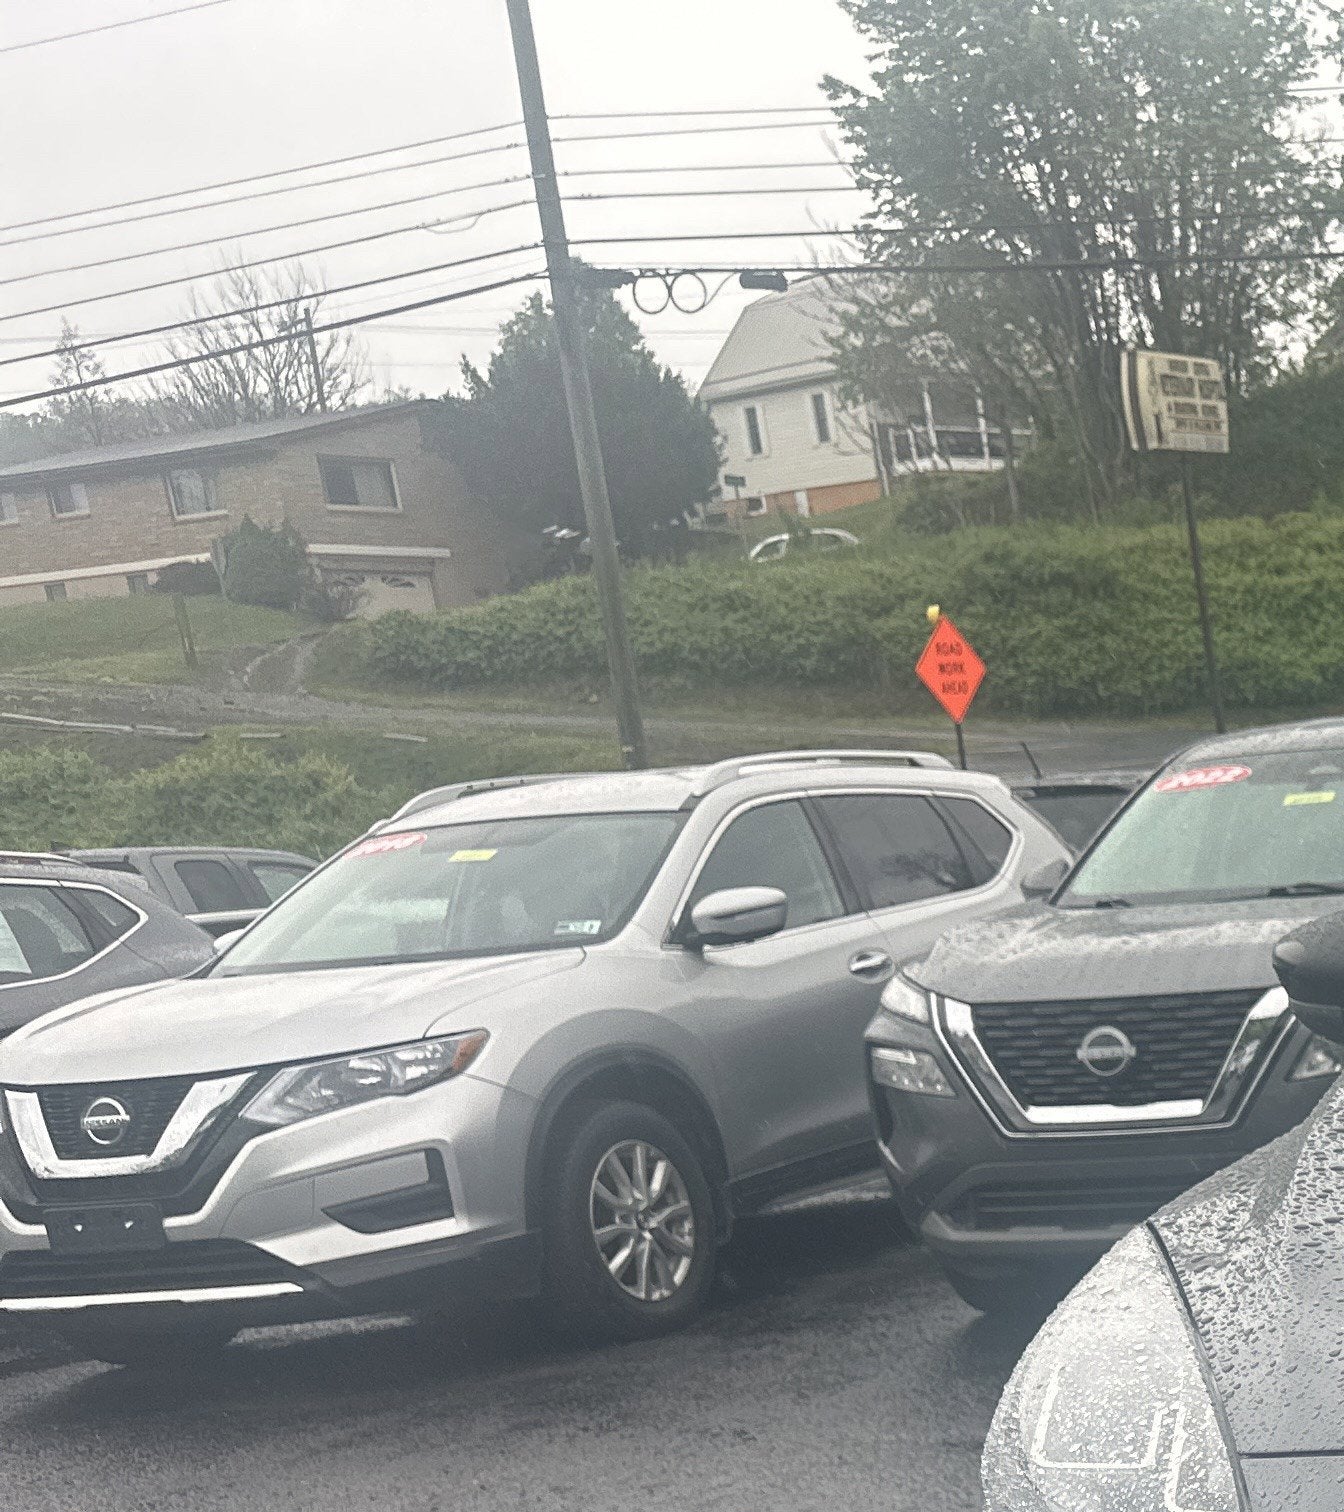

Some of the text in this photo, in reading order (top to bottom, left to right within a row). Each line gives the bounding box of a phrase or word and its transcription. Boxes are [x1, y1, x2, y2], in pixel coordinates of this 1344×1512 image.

[935, 641, 963, 657] ROAD
[938, 661, 966, 676] WORK
[942, 680, 969, 695] AHEAD
